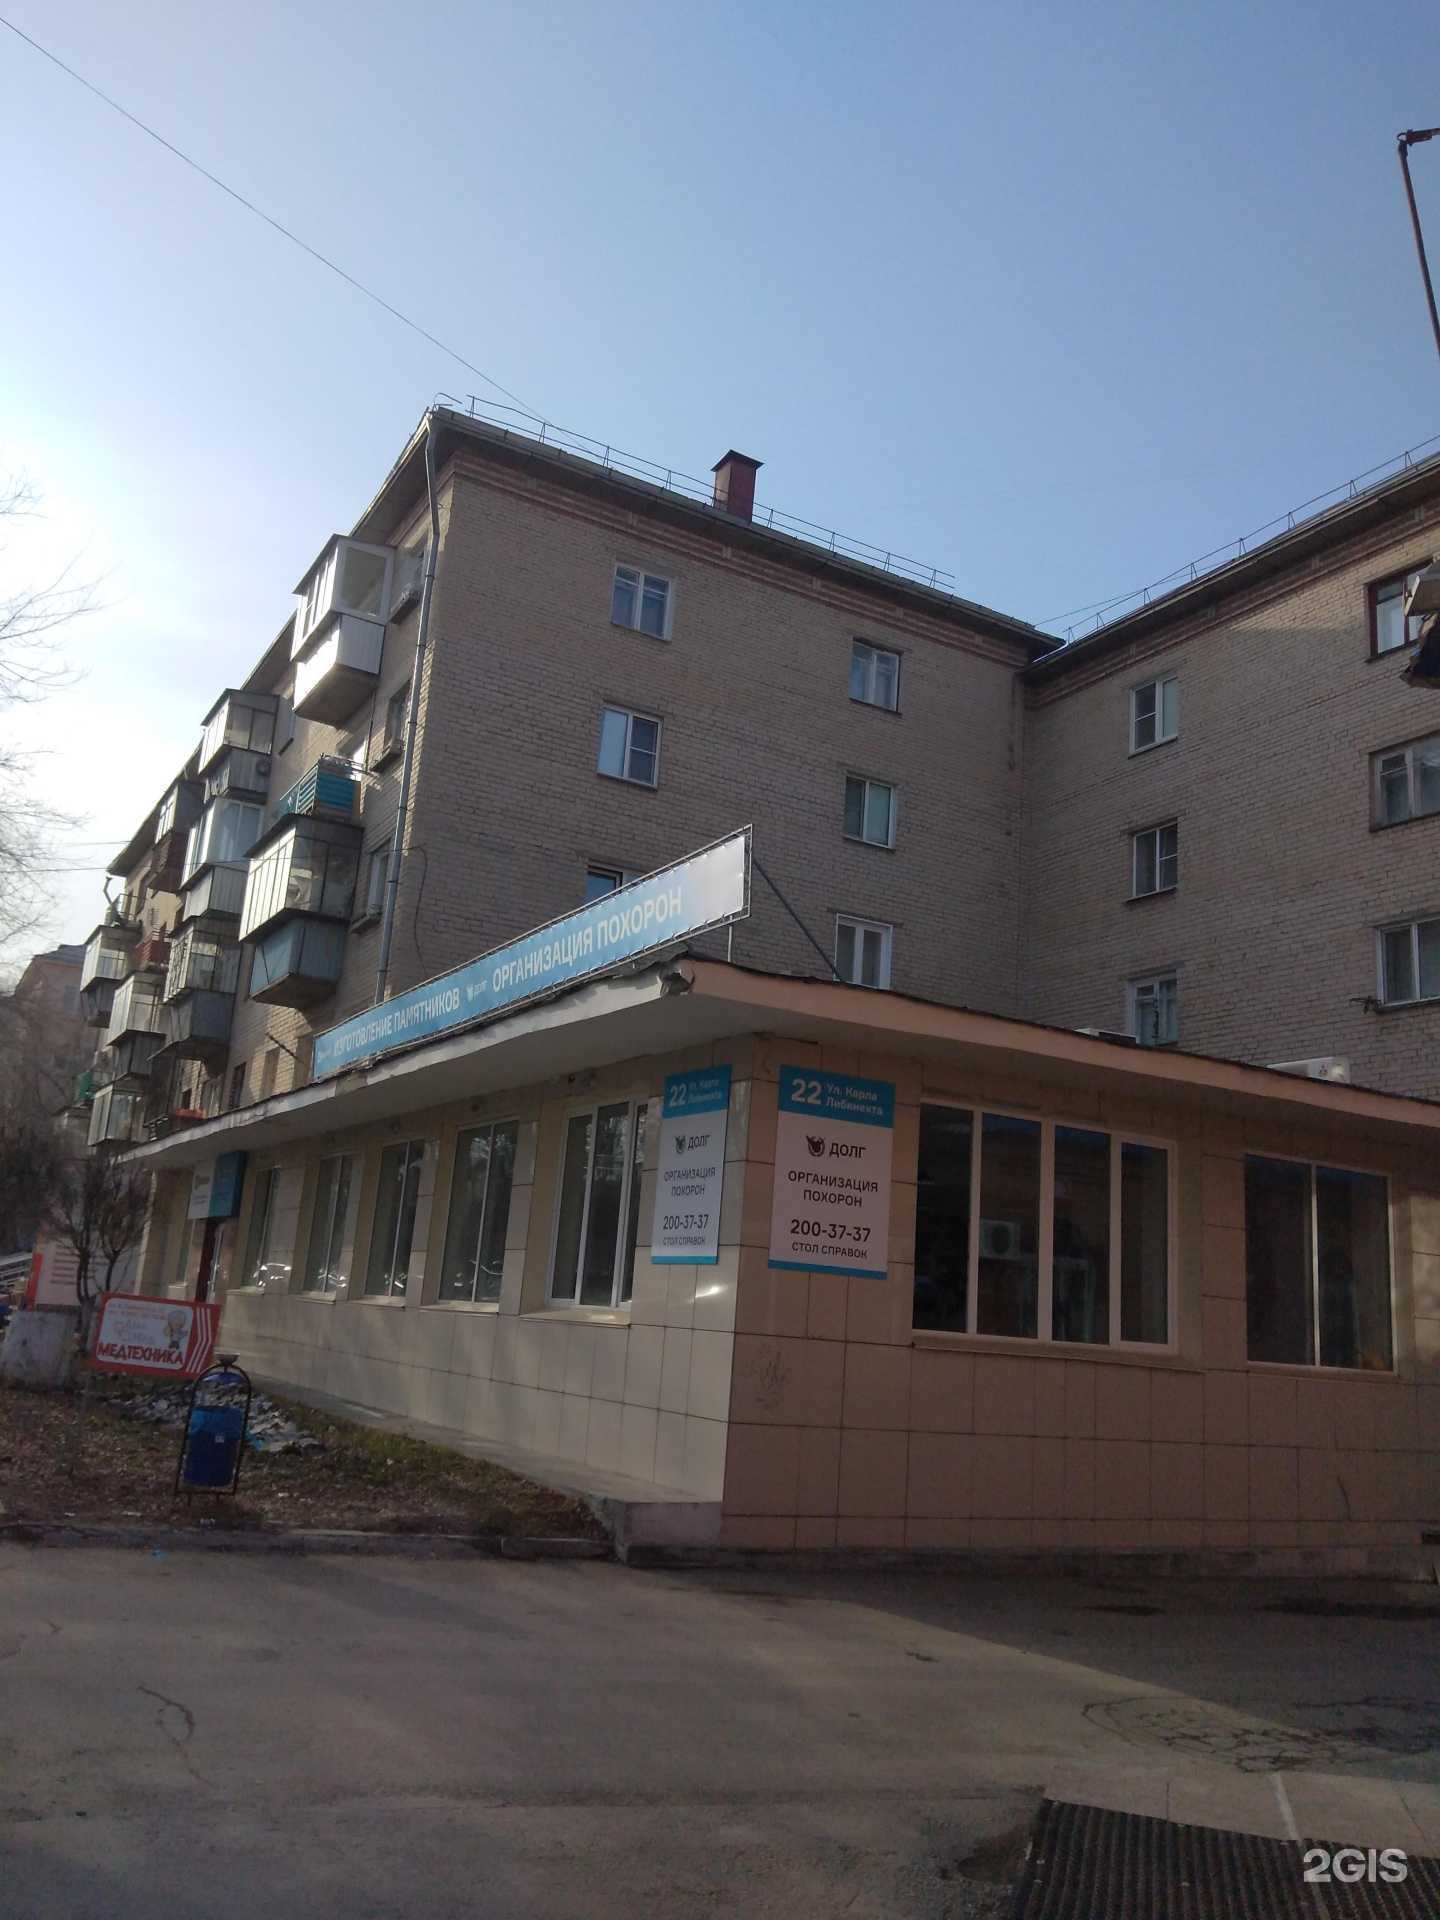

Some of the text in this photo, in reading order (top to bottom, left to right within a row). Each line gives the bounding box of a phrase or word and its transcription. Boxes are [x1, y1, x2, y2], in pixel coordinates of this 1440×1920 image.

[492, 886, 682, 992] ОРГАНИЗАЦИЯ ПОХОРОН
[394, 988, 460, 1032] ПАМЯТНИКОВ
[670, 1083, 688, 1106] 22
[791, 1078, 822, 1105] 22
[687, 1134, 711, 1150] ДОЛГ
[829, 1142, 867, 1159] ДОЛГ
[663, 1166, 717, 1183] ОРГАНИЗАЦИЯ
[787, 1170, 879, 1193] ОРГАНИЗАЦИЯ
[671, 1184, 706, 1197] ПОХОРОН
[803, 1189, 863, 1208] ПОХОРОН
[663, 1214, 710, 1231] 200-37-37
[790, 1219, 872, 1242] 200-37-37
[791, 1241, 868, 1259] СТОЛ СПРАВОК
[96, 1343, 184, 1365] МЕДТЕХНИКА
